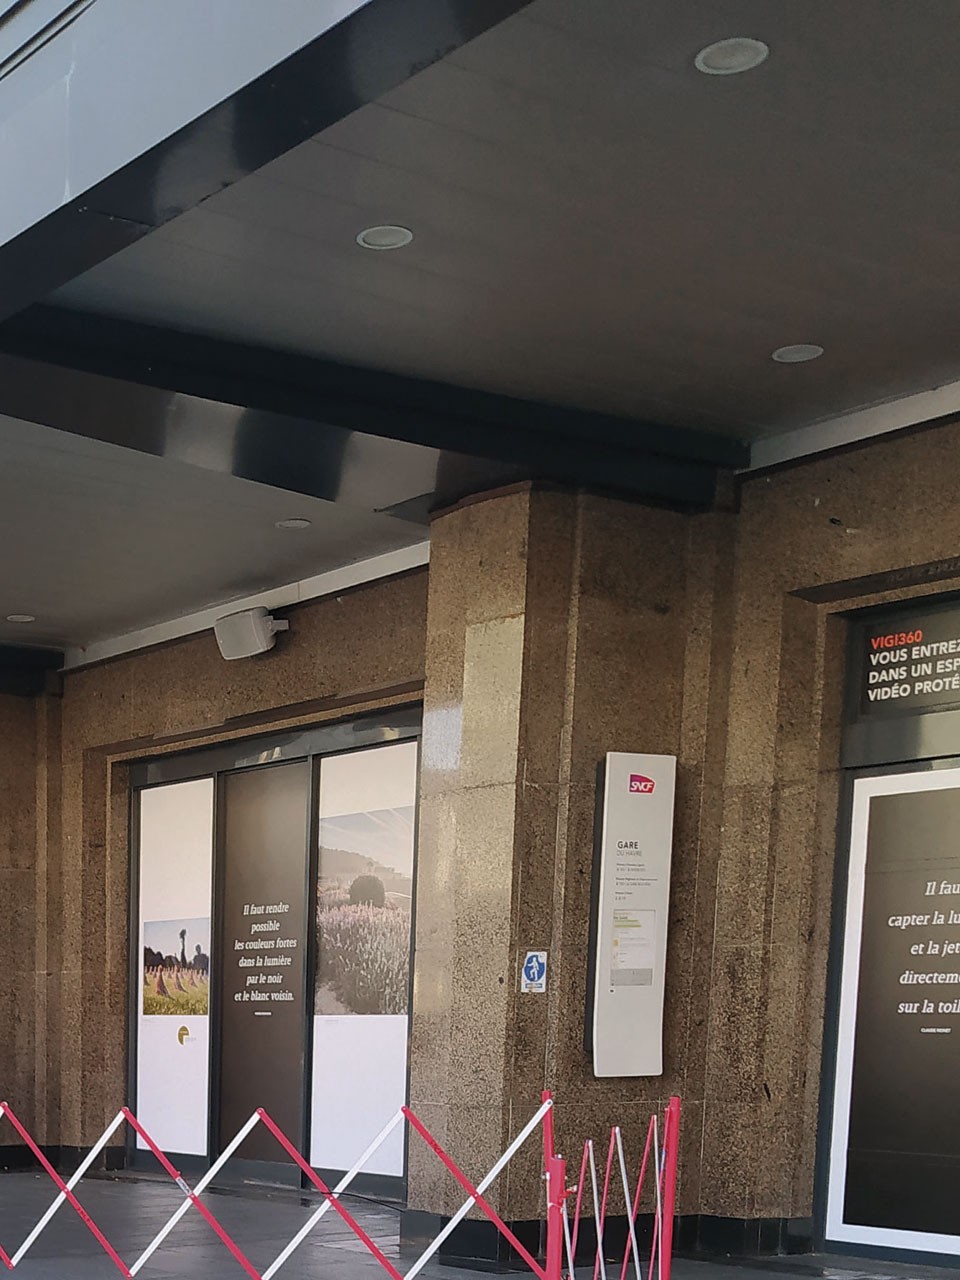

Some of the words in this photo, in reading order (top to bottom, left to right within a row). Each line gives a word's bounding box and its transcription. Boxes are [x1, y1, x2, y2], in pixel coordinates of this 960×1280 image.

[871, 630, 923, 649] VIGI360
[870, 649, 908, 666] VOUS
[868, 668, 907, 684] DANS
[911, 663, 933, 678] UN
[868, 683, 911, 702] VIDÉO
[630, 781, 654, 792] SNCF
[617, 840, 639, 850] GARE
[924, 881, 936, 896] Il
[243, 904, 249, 916] Il
[250, 903, 265, 915] faut
[266, 902, 289, 914] rendre
[251, 920, 281, 934] possible
[888, 913, 930, 930] capter
[932, 911, 945, 925] la
[234, 940, 244, 950] les
[245, 938, 275, 950] couleurs
[275, 938, 297, 949] fortes
[910, 943, 924, 955] et
[926, 940, 939, 955] la
[239, 956, 255, 967] dans
[256, 955, 263, 967] la
[263, 954, 292, 967] lumière
[246, 975, 258, 987] par
[259, 973, 267, 984] le
[267, 972, 283, 984] noir
[234, 991, 242, 1001] et
[242, 990, 250, 1001] le
[250, 990, 270, 1001] blanc
[270, 990, 294, 1001] voisin.
[897, 1002, 920, 1014] sur
[921, 999, 934, 1014] la
